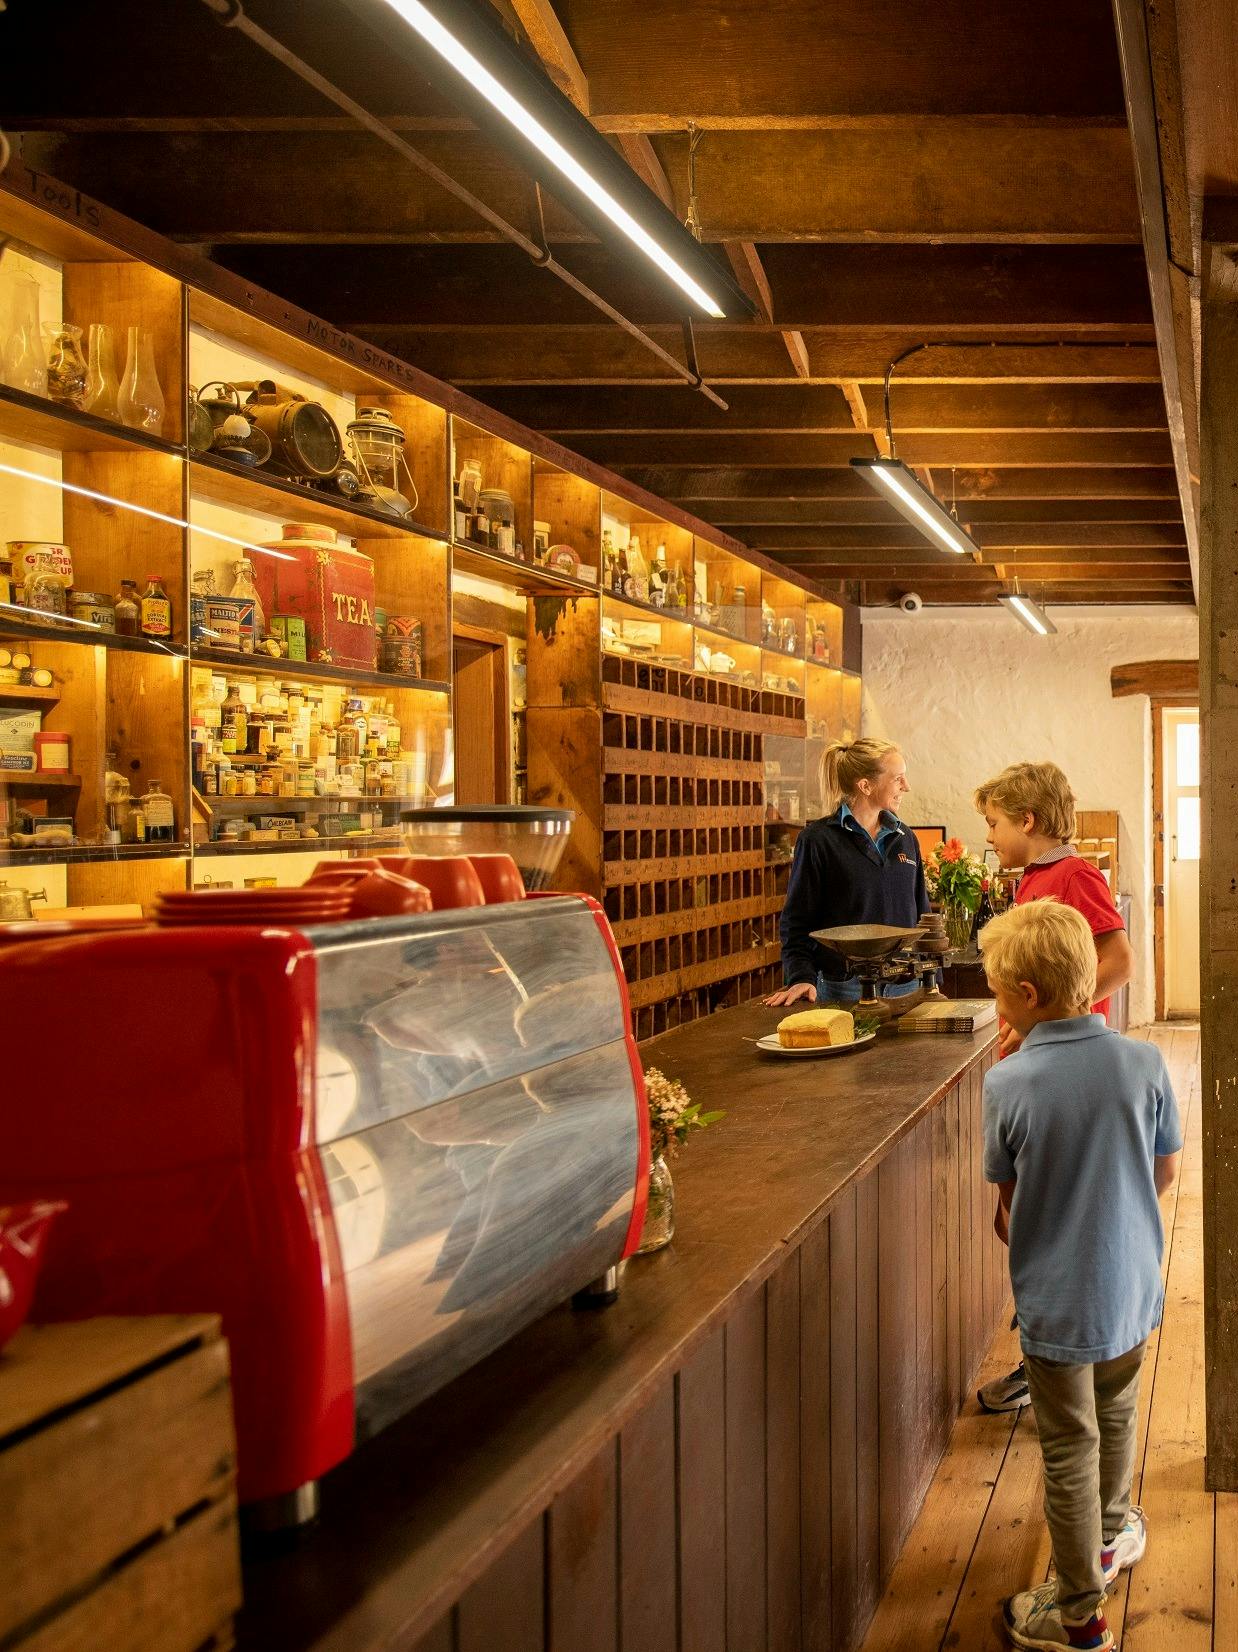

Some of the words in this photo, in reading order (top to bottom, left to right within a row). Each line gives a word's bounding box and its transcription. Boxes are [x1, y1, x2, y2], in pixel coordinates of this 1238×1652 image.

[24, 166, 103, 228] Tools
[306, 319, 356, 357] MOTOR
[361, 348, 416, 382] SPARES
[332, 591, 373, 627] TEA
